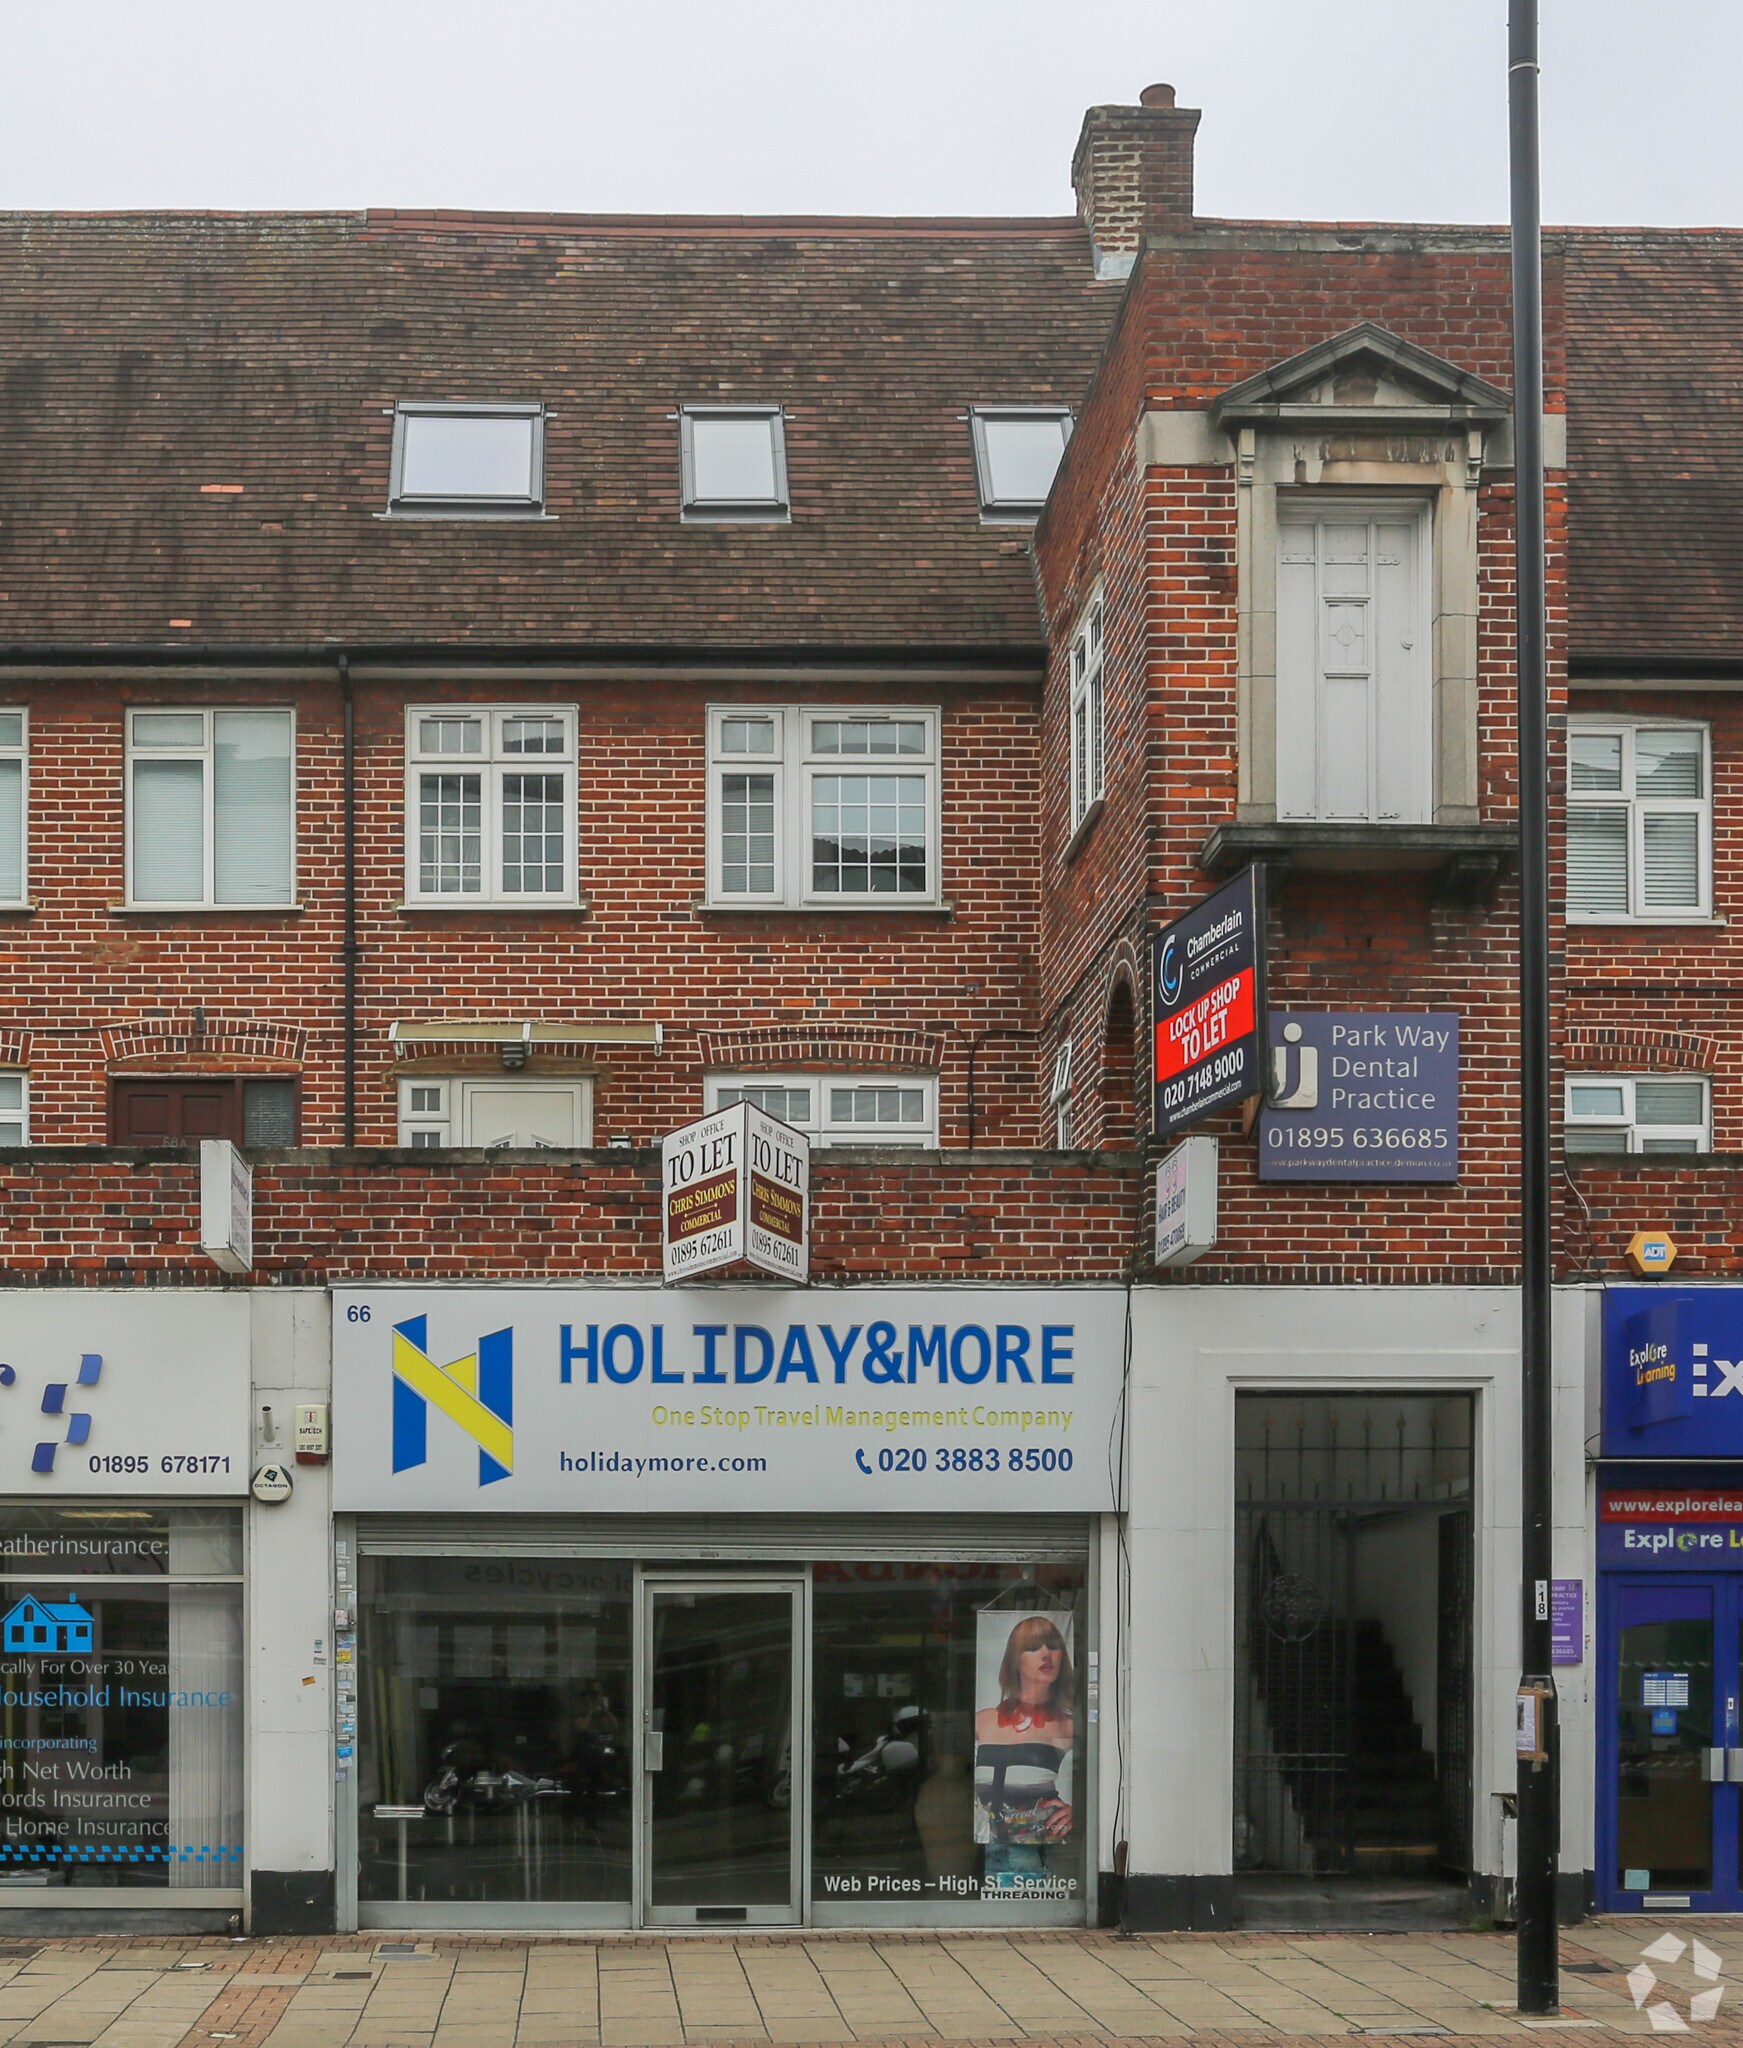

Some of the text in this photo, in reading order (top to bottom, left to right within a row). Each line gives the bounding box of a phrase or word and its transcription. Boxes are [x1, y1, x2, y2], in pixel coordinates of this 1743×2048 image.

[1187, 909, 1242, 958] Chamberlain
[1190, 943, 1239, 980] COMMERCIAL
[1169, 977, 1241, 1042] LOCK UP SHOP
[1181, 1009, 1229, 1065] TO LET
[1332, 1024, 1449, 1052] Park Way
[1163, 1047, 1244, 1109] 020 7148 9000
[1332, 1056, 1418, 1078] Dental
[1168, 1079, 1242, 1123] www.chamberlaincommercial.com
[1332, 1087, 1436, 1110] Practice
[679, 1131, 697, 1148] SHOP
[701, 1120, 725, 1138] OFFICE
[760, 1120, 795, 1149] SHOP OFFICE
[1268, 1128, 1448, 1148] 01895 636685
[668, 1132, 737, 1188] TO LET
[752, 1133, 803, 1189] TO LET
[670, 1179, 736, 1217] CHRIS SIMMONS
[752, 1179, 802, 1217] CHRIS SIMMONS
[680, 1209, 723, 1233] COMMERCIAL
[759, 1210, 791, 1234] COMMERCIAL
[671, 1229, 733, 1266] 01895 672611
[752, 1229, 799, 1267] 01895 672611
[1643, 1245, 1667, 1259] ADT
[347, 1306, 371, 1323] 66
[559, 1320, 1075, 1385] HOLIDAY&MORE
[652, 1404, 1073, 1432] One Stop Travel Management Company
[89, 1455, 231, 1474] 01895 678171
[560, 1451, 767, 1478] holidaymore.com
[878, 1448, 1074, 1472] 020 3883 8500
[41, 1660, 65, 1675] For
[70, 1660, 110, 1675] Over
[114, 1660, 134, 1675] 30
[120, 1686, 232, 1708] Insurance
[0, 1736, 98, 1753] incorporating
[23, 1761, 60, 1780] Net
[66, 1760, 131, 1780] Worth
[54, 1789, 151, 1808] Insurance
[6, 1817, 69, 1836] Home
[824, 1876, 861, 1892] Web
[868, 1876, 921, 1892] Prices
[939, 1876, 978, 1895] High
[984, 1875, 1002, 1891] St
[1013, 1875, 1077, 1891] Service
[983, 1891, 1066, 1899] THREADING
